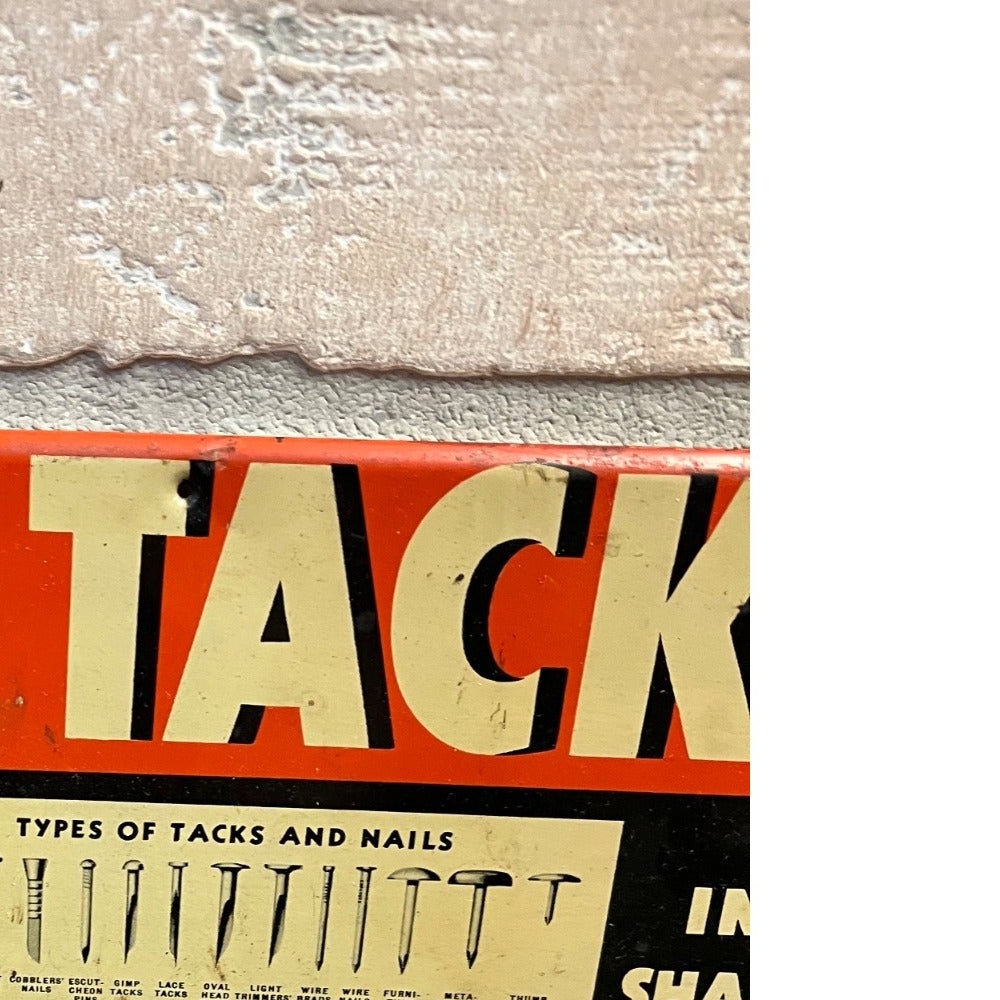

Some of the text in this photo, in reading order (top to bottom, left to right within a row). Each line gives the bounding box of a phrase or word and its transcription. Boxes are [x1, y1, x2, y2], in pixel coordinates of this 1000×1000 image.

[16, 817, 454, 851] TYPES OF TACKS AND NAILS
[113, 980, 140, 988] GIMP
[158, 981, 185, 989] LACE
[203, 983, 230, 991] OVAL
[21, 985, 52, 993] NAILS
[68, 986, 103, 995] CHEON
[110, 988, 143, 996] TACKS
[250, 984, 282, 993] LIGHT
[301, 987, 329, 995] WIRE
[342, 988, 370, 997] WIRE
[154, 990, 188, 998] TACKS
[201, 991, 230, 1000] HEAD
